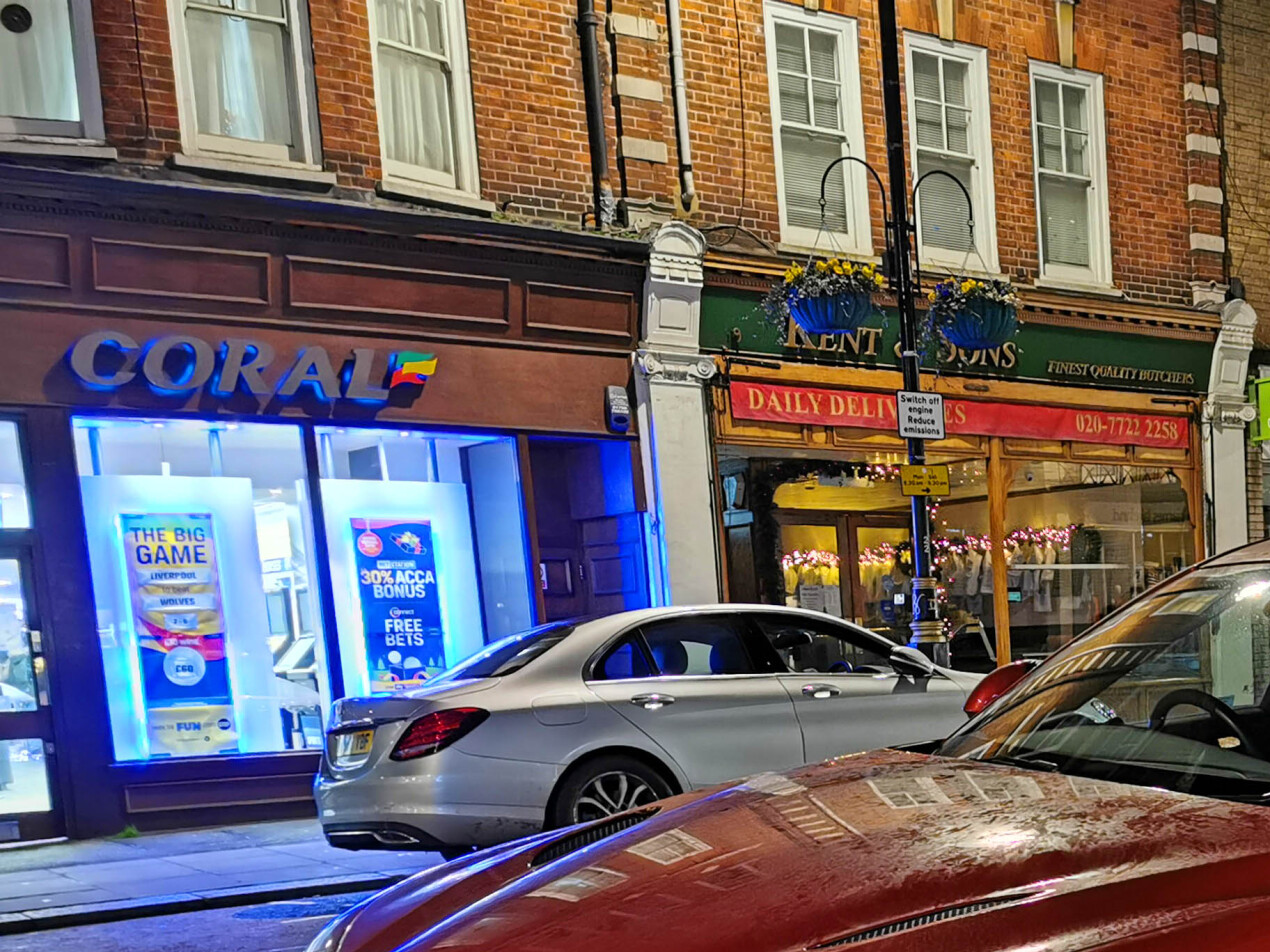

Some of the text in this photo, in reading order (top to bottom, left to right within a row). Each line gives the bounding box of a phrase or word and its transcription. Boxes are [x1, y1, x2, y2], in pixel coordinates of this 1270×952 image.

[784, 315, 883, 356] KENT
[71, 330, 391, 400] CORAL
[1048, 361, 1194, 385] FINEST QUALITY BUTCHERS
[901, 395, 927, 404] Switch
[748, 387, 822, 416] DAILY
[1076, 413, 1140, 435] 020-7722
[1145, 419, 1178, 440] 2258
[909, 406, 933, 415] engine
[908, 415, 935, 425] Reduce
[904, 426, 940, 435] emissions
[129, 527, 205, 542] THE BIG
[136, 545, 207, 565] GAME
[150, 572, 197, 580] LIVERPOOL
[361, 569, 435, 585] 30% ACCA
[373, 584, 426, 598] BONUS
[160, 598, 195, 606] WOLVES
[385, 618, 423, 632] FREE
[385, 633, 424, 646] BETS
[176, 722, 201, 731] FUN
